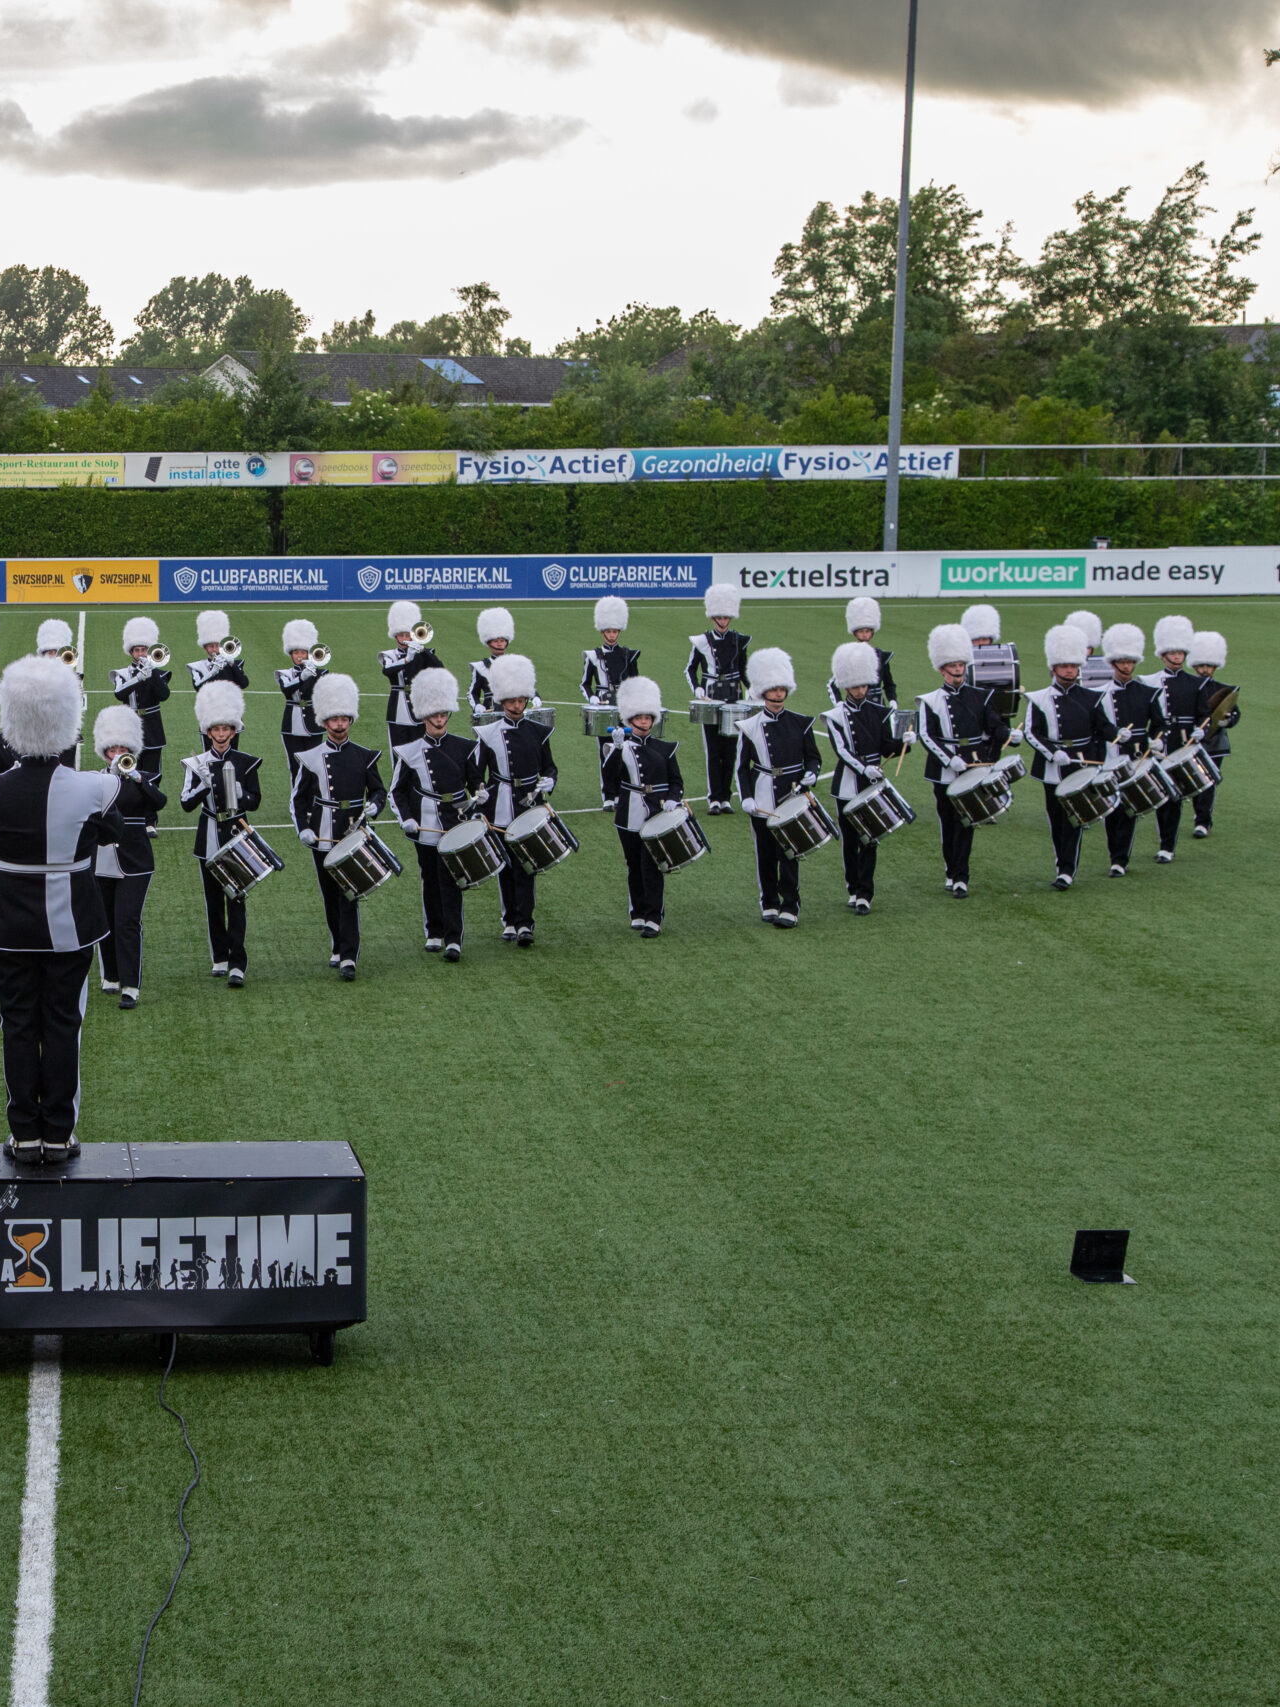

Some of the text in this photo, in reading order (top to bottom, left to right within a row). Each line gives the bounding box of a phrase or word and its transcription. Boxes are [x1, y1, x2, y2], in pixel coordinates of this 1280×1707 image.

[81, 459, 93, 468] de
[95, 459, 119, 470] Stolp
[214, 459, 240, 469] otte
[400, 463, 452, 472] speedbooks
[459, 454, 627, 480] Fysio Actief
[642, 451, 773, 474] Gezondheid!
[784, 451, 954, 475] Fysio Actief
[13, 574, 65, 584] SWZSHOP.NL
[100, 574, 152, 584] SWZSHOP.NL
[201, 568, 328, 584] CLUBFABRIEK.NL
[385, 567, 512, 583] CLUBFABRIEK.NL
[570, 566, 697, 582] CLUBFABRIEK.NL
[740, 563, 890, 588] textielstra
[947, 560, 1225, 585] workwear made easy
[1, 1259, 16, 1282] A
[60, 1213, 352, 1292] LIFETIME
